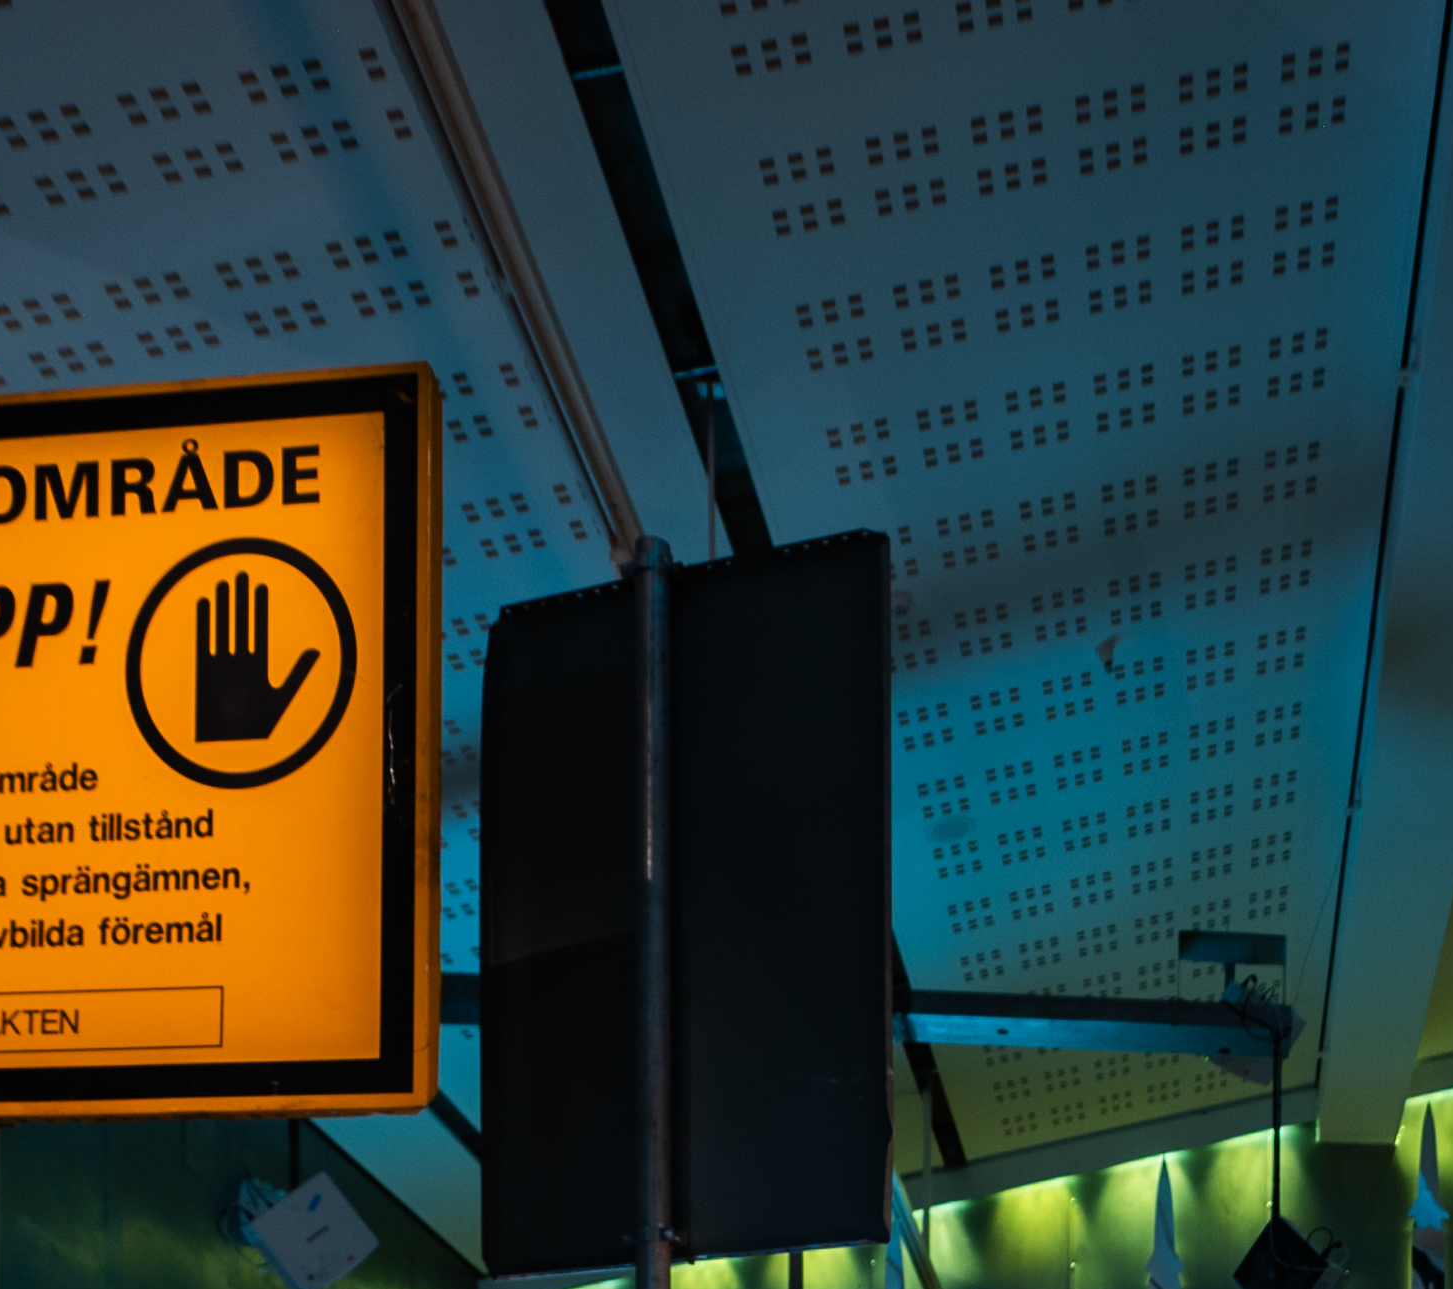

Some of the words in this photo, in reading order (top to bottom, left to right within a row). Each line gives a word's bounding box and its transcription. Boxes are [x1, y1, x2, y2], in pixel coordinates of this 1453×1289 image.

[2, 815, 75, 847] utan
[86, 806, 215, 843] tillstånd
[19, 861, 251, 903] sprängämnen,
[96, 910, 223, 946] föremål
